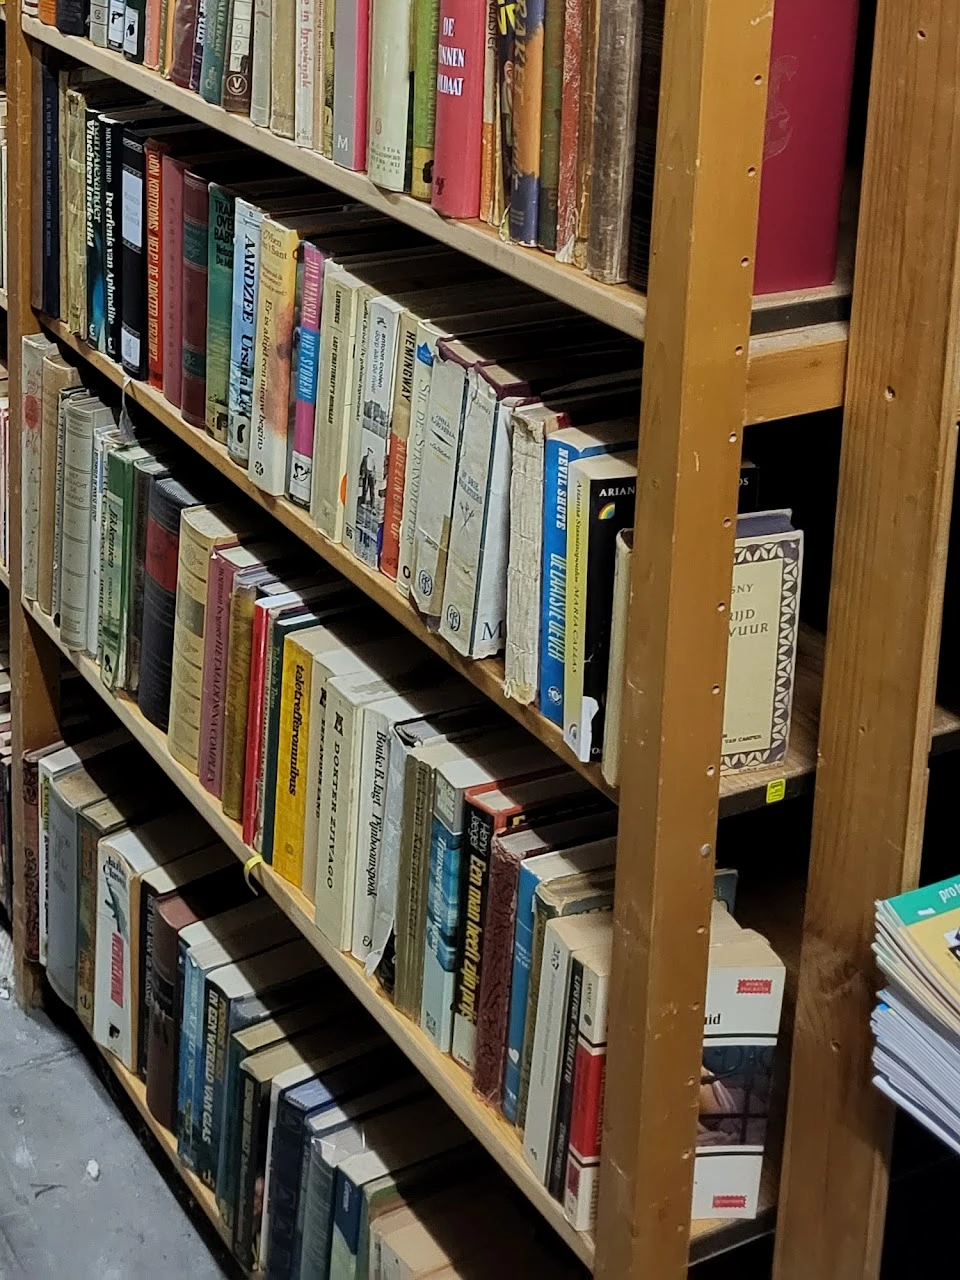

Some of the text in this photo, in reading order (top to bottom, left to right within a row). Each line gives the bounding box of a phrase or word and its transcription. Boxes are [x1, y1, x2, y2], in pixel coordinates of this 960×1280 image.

[443, 17, 455, 37] DE
[105, 204, 115, 248] erfenis
[148, 177, 160, 231] KORTOOMS
[105, 268, 116, 325] Aphrodite
[148, 280, 159, 317] DOKTER
[238, 234, 256, 385] AARDZEE Ursula
[265, 298, 273, 316] Er
[302, 257, 319, 326] JILL MANSELL
[333, 289, 342, 325] LAWRENCE
[262, 326, 272, 357] altijd
[298, 332, 316, 400] NIET STOREN!
[261, 357, 269, 379] een
[401, 330, 416, 403] HEMINGWAY
[259, 378, 268, 414] nieuw
[395, 454, 405, 467] DE
[396, 438, 406, 454] EN
[394, 468, 404, 491] ZON
[555, 447, 569, 531] NEVIL SHUTE
[392, 493, 402, 521] GAAT
[210, 662, 222, 728] MADONNA
[206, 727, 218, 786] COMPLEX
[374, 730, 387, 769] Bouke
[326, 740, 341, 889] DOKTER ZJIVAGO
[370, 780, 383, 808] Jagt
[365, 812, 382, 899] Pijnboomspook
[459, 854, 486, 1024] Een man heeft zijn prijs
[563, 974, 582, 1085] LIPSTICK STILETTO
[201, 988, 220, 1145] IN EEN WERELD VAN GLAS
